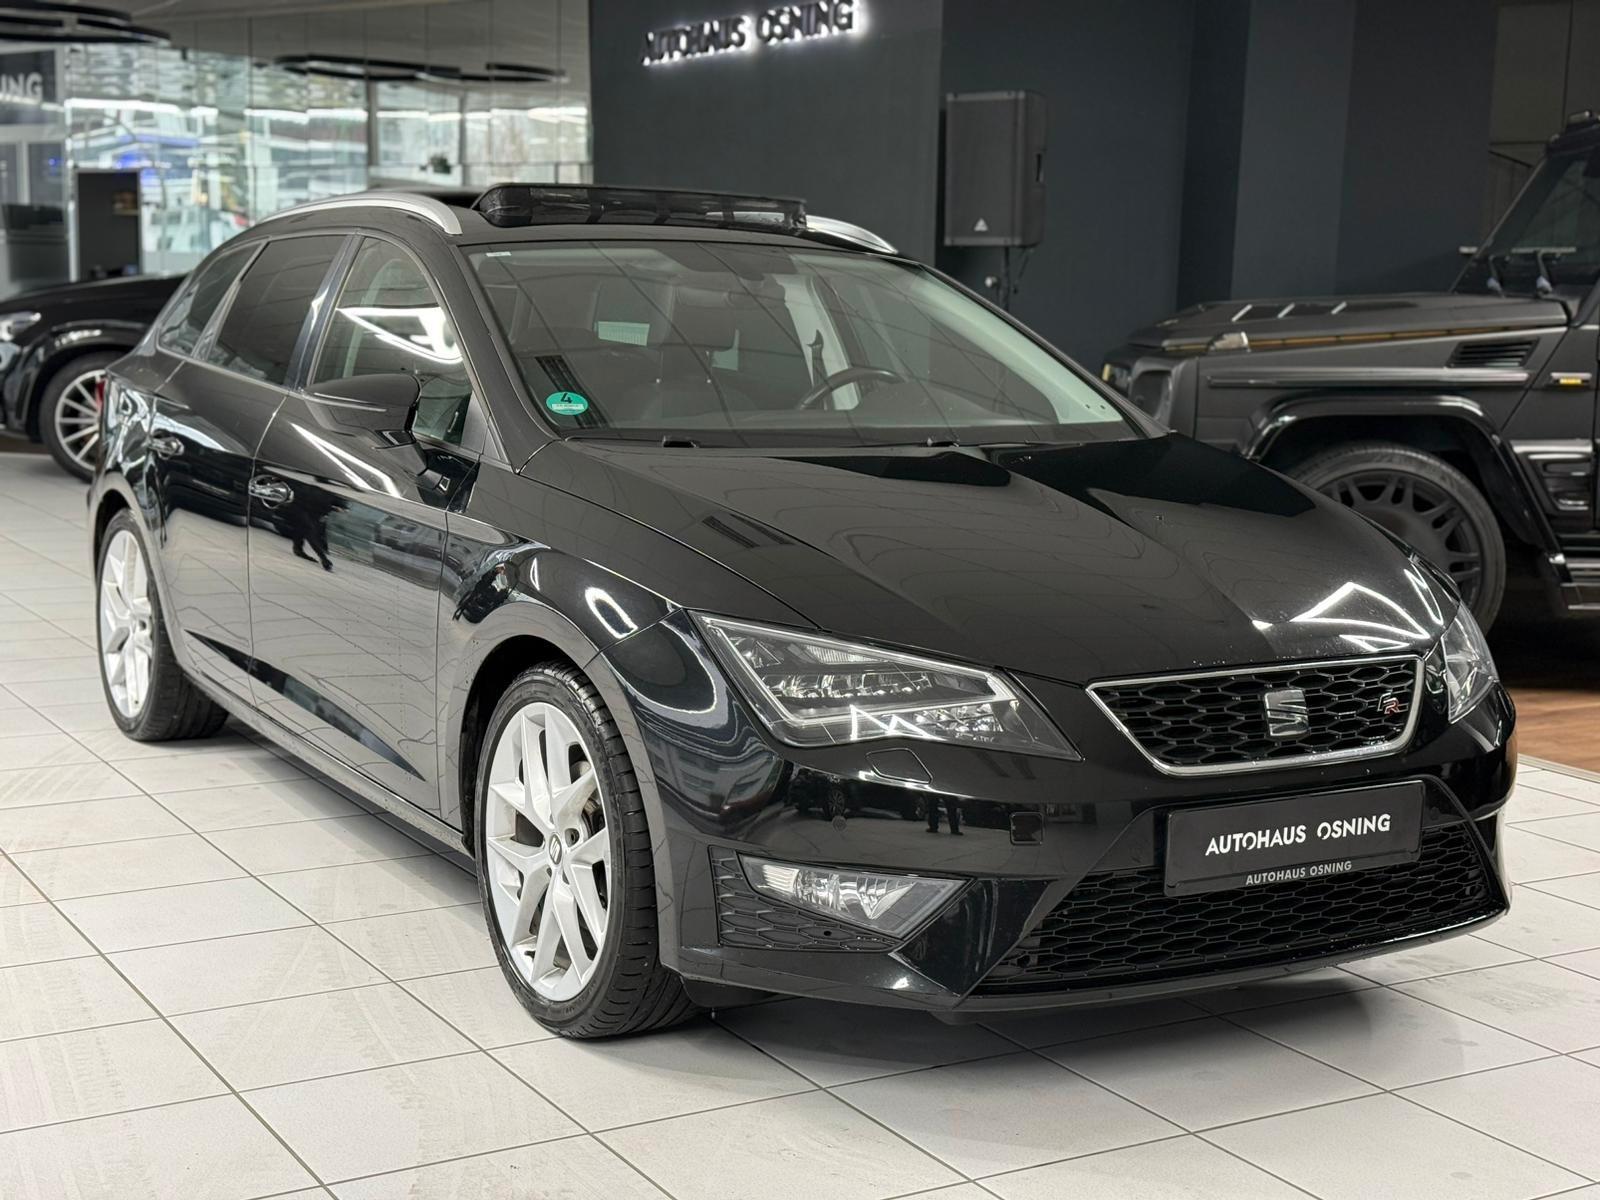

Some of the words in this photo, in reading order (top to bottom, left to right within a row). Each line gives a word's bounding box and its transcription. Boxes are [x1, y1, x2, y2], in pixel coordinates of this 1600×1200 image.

[560, 392, 573, 404] 4
[1205, 825, 1307, 856] AUTOHAUS
[1316, 813, 1391, 840] OSNING
[1245, 866, 1306, 886] AUTOHAUS
[1309, 860, 1353, 876] OSNING
